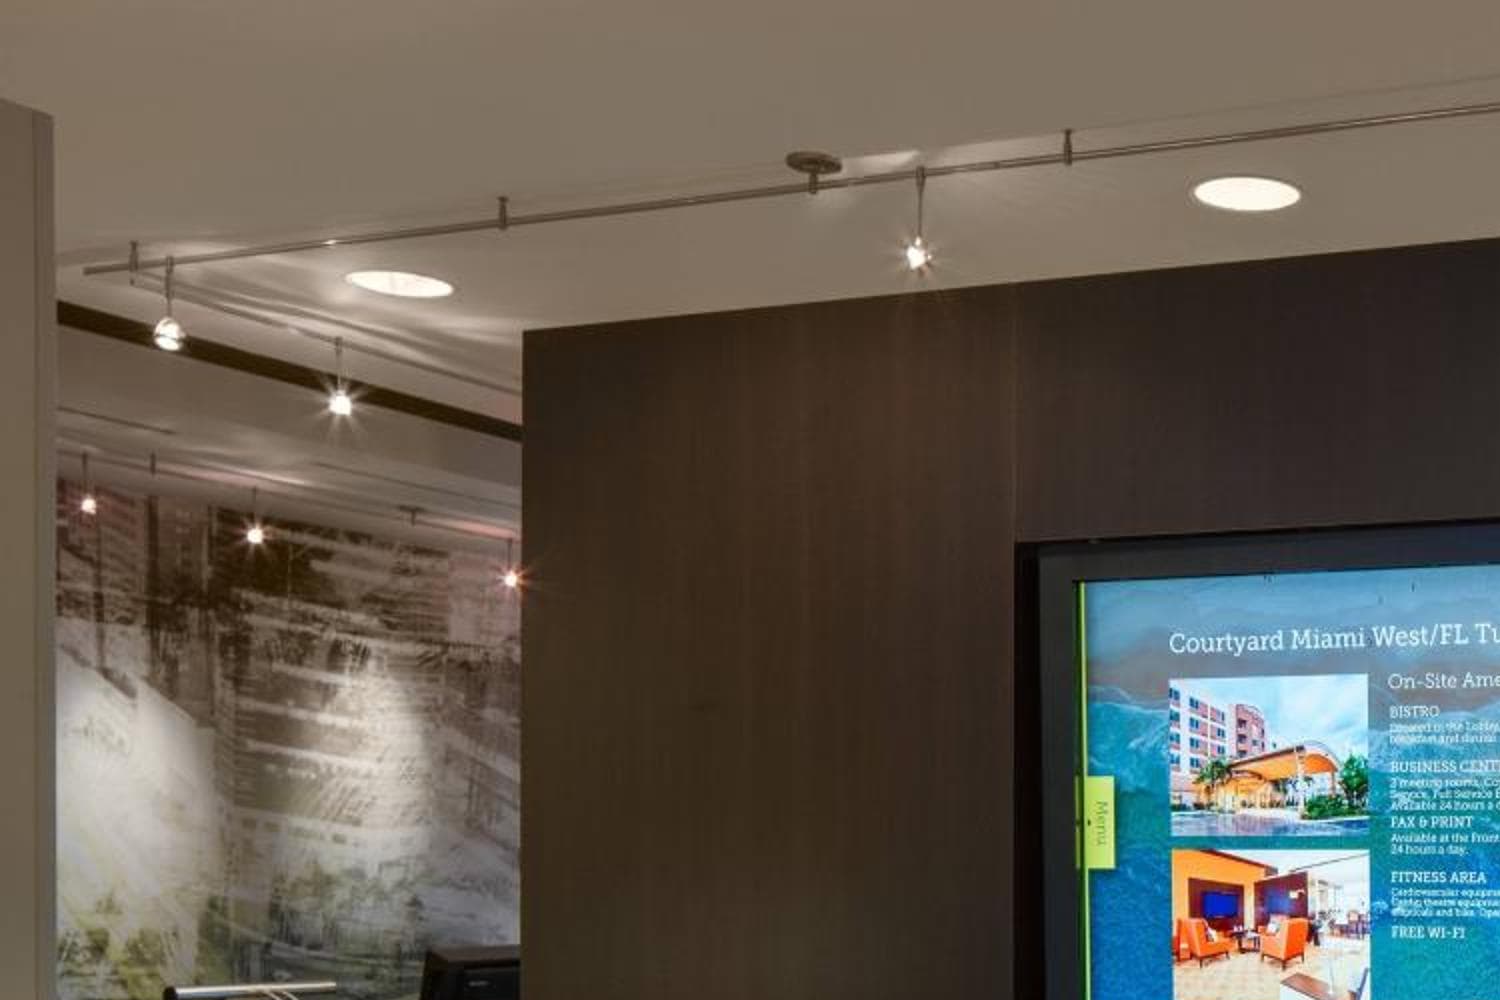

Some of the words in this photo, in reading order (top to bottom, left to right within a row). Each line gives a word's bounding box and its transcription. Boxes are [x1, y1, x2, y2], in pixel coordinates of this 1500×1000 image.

[1169, 630, 1284, 657] Courtyard
[1291, 627, 1366, 650] Miami
[1370, 622, 1470, 649] West/FL
[1388, 672, 1457, 689] On-Site
[1390, 705, 1441, 718] BISTRO
[1391, 760, 1457, 773] BUSINESS
[1391, 816, 1416, 828] FAX
[1431, 815, 1474, 828] PRINT
[1391, 871, 1447, 884] FITNESS
[1450, 871, 1487, 884] AREA
[1391, 926, 1425, 939] FREE
[1429, 926, 1466, 939] WI-FI
